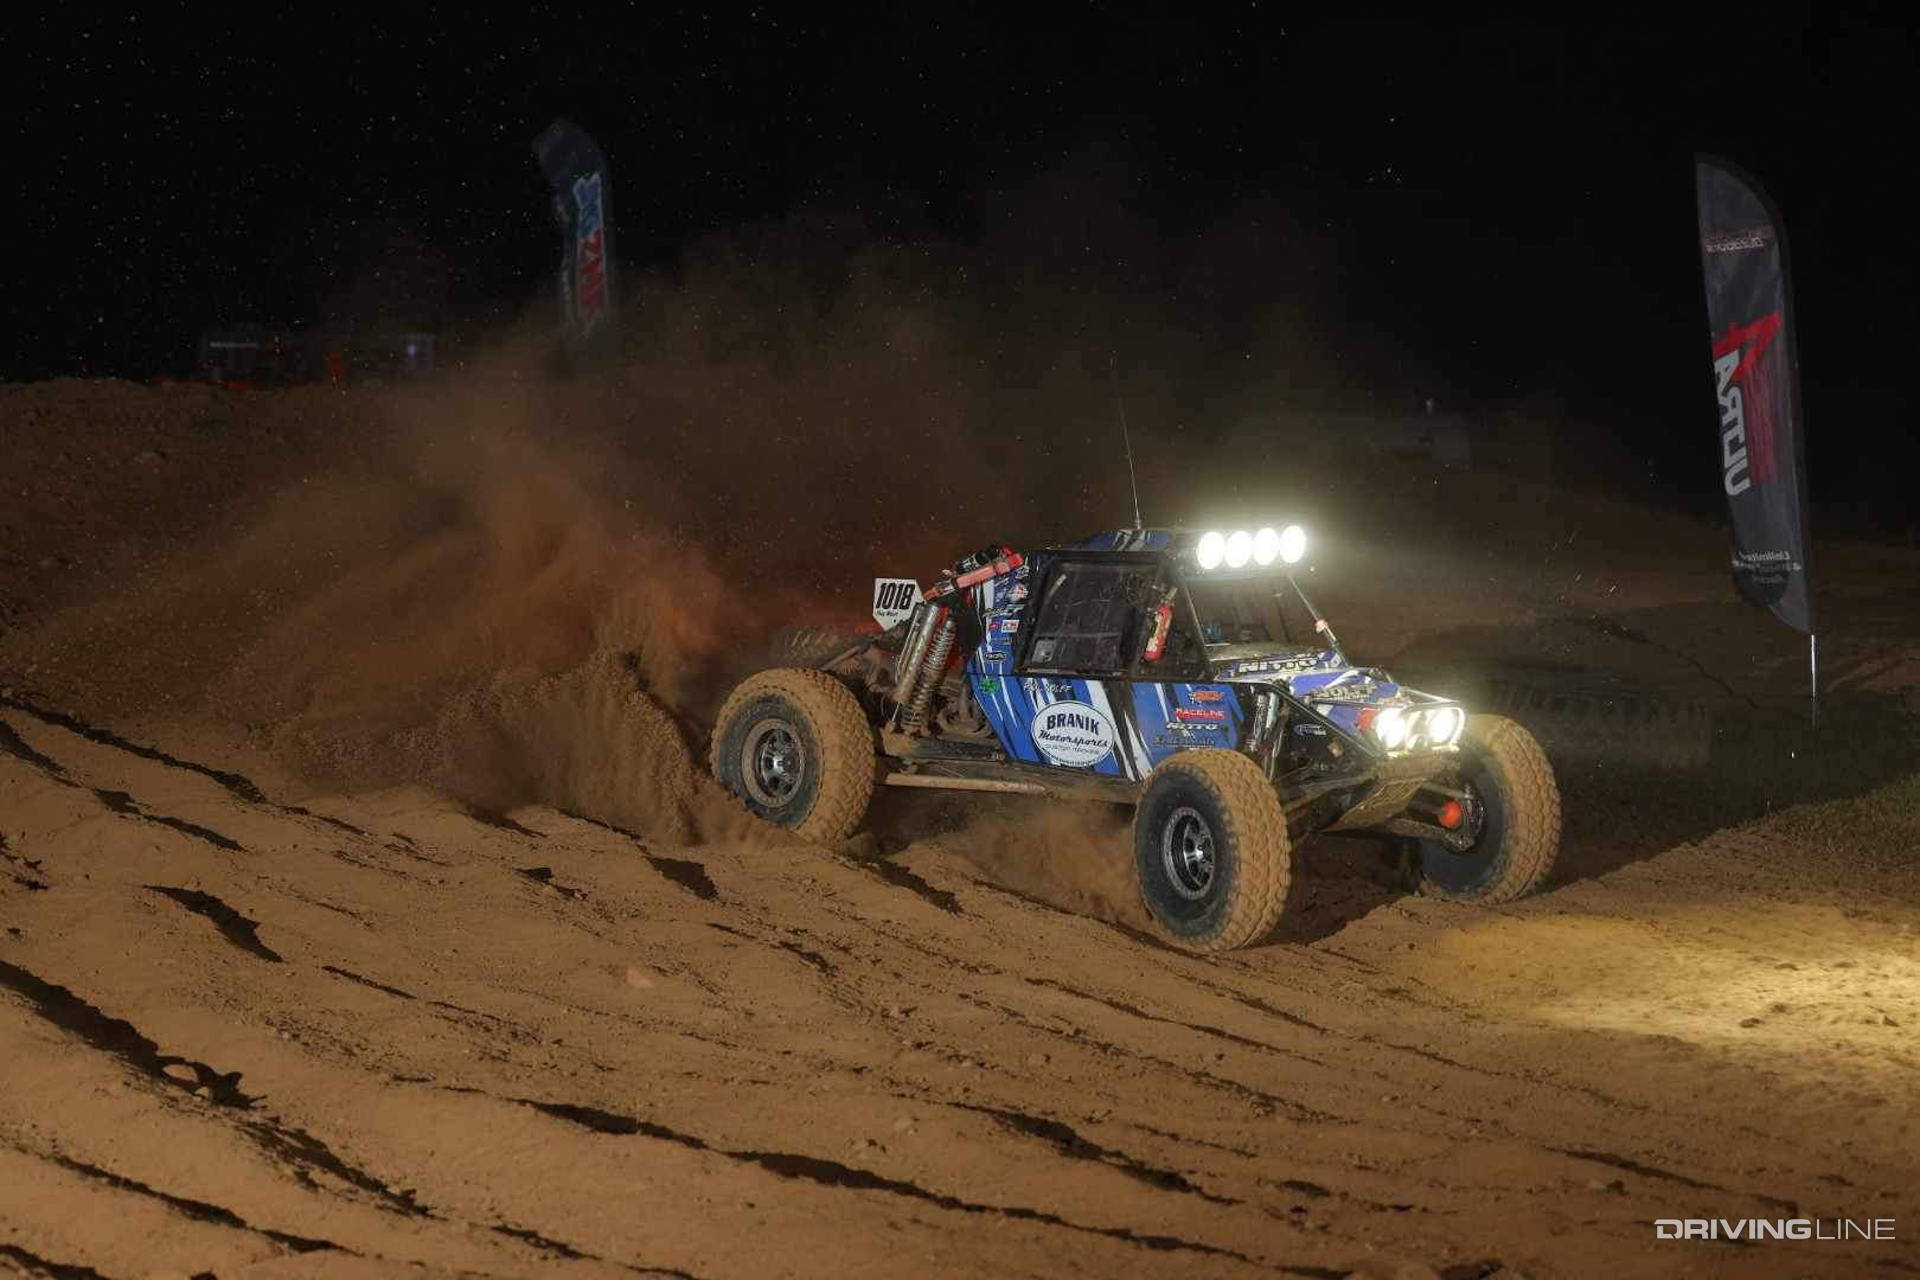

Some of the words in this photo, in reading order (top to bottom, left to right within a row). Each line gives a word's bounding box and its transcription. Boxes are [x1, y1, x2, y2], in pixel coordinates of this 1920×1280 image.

[876, 582, 916, 610] 1018
[1046, 713, 1100, 736] BRANIK
[1038, 729, 1108, 747] Motorsports
